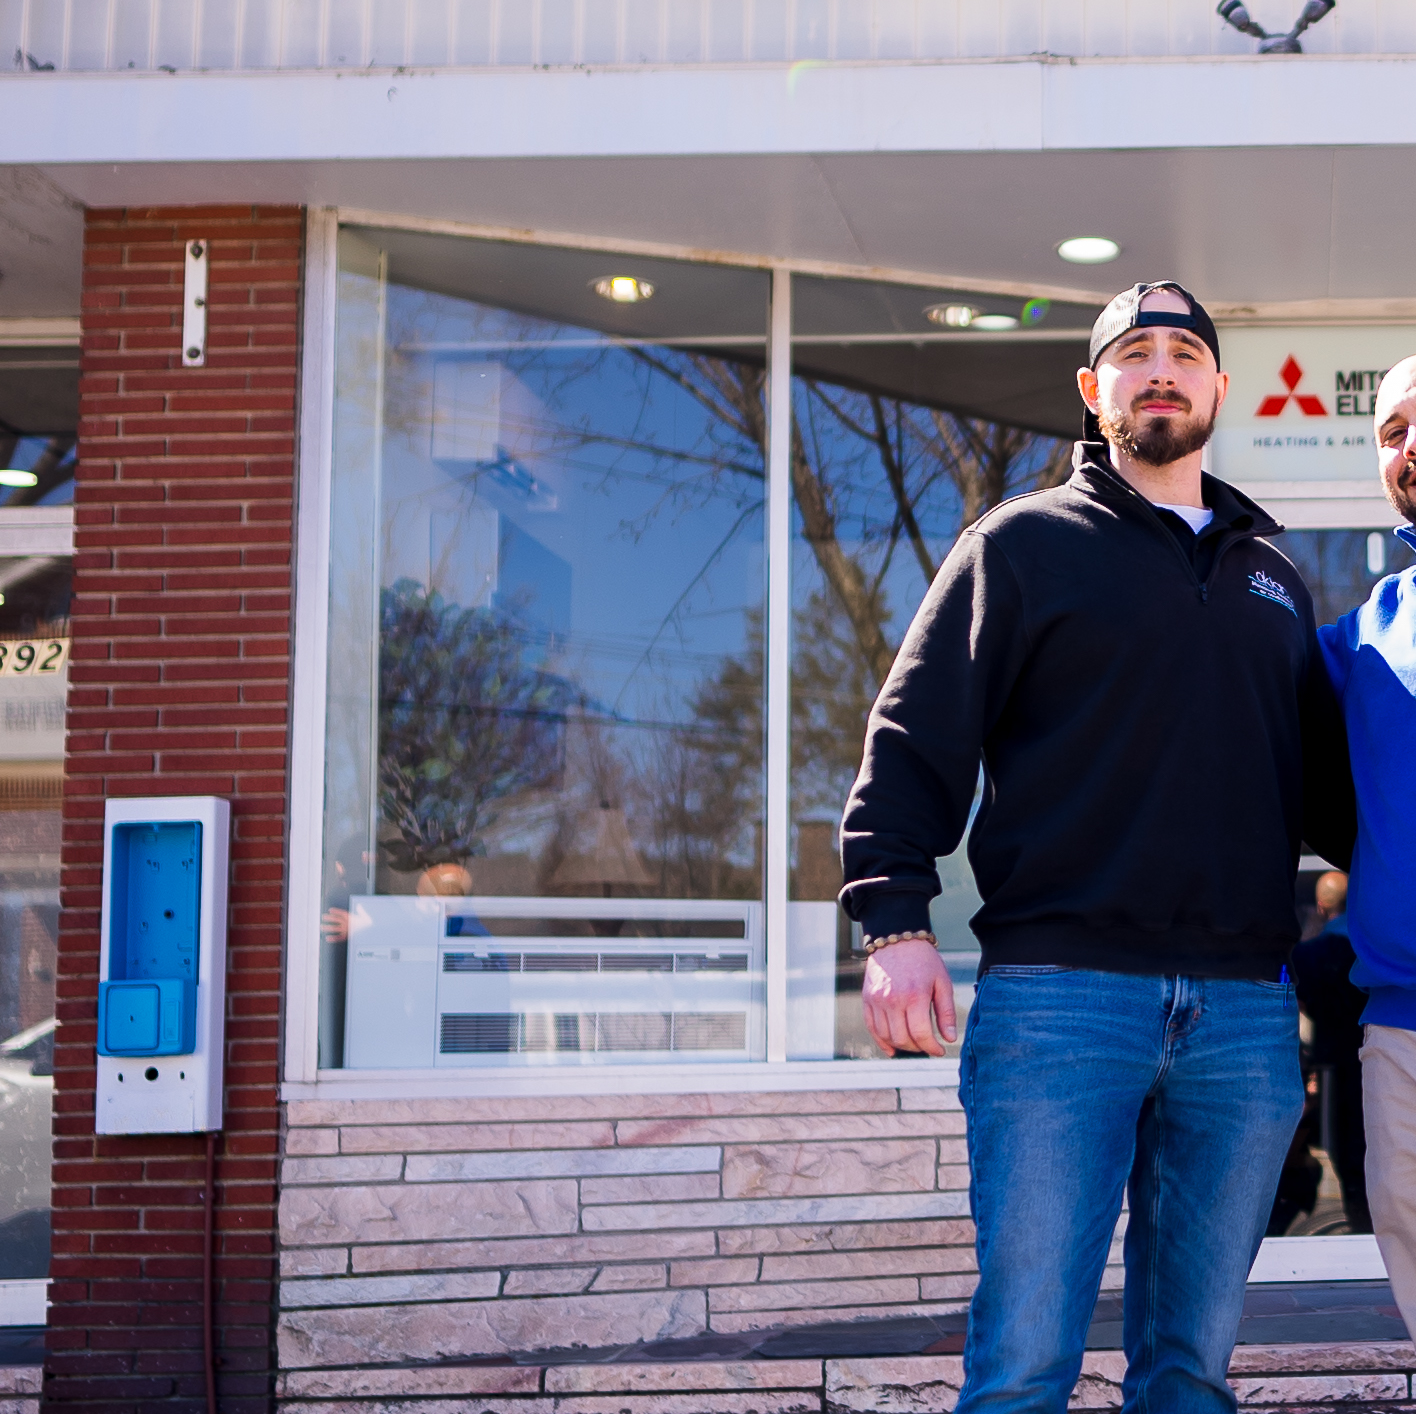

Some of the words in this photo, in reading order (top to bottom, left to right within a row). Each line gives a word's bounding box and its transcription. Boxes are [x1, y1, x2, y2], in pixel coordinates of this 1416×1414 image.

[1253, 436, 1318, 447] HEATING
[1325, 436, 1334, 447] &
[1341, 436, 1365, 446] AIR
